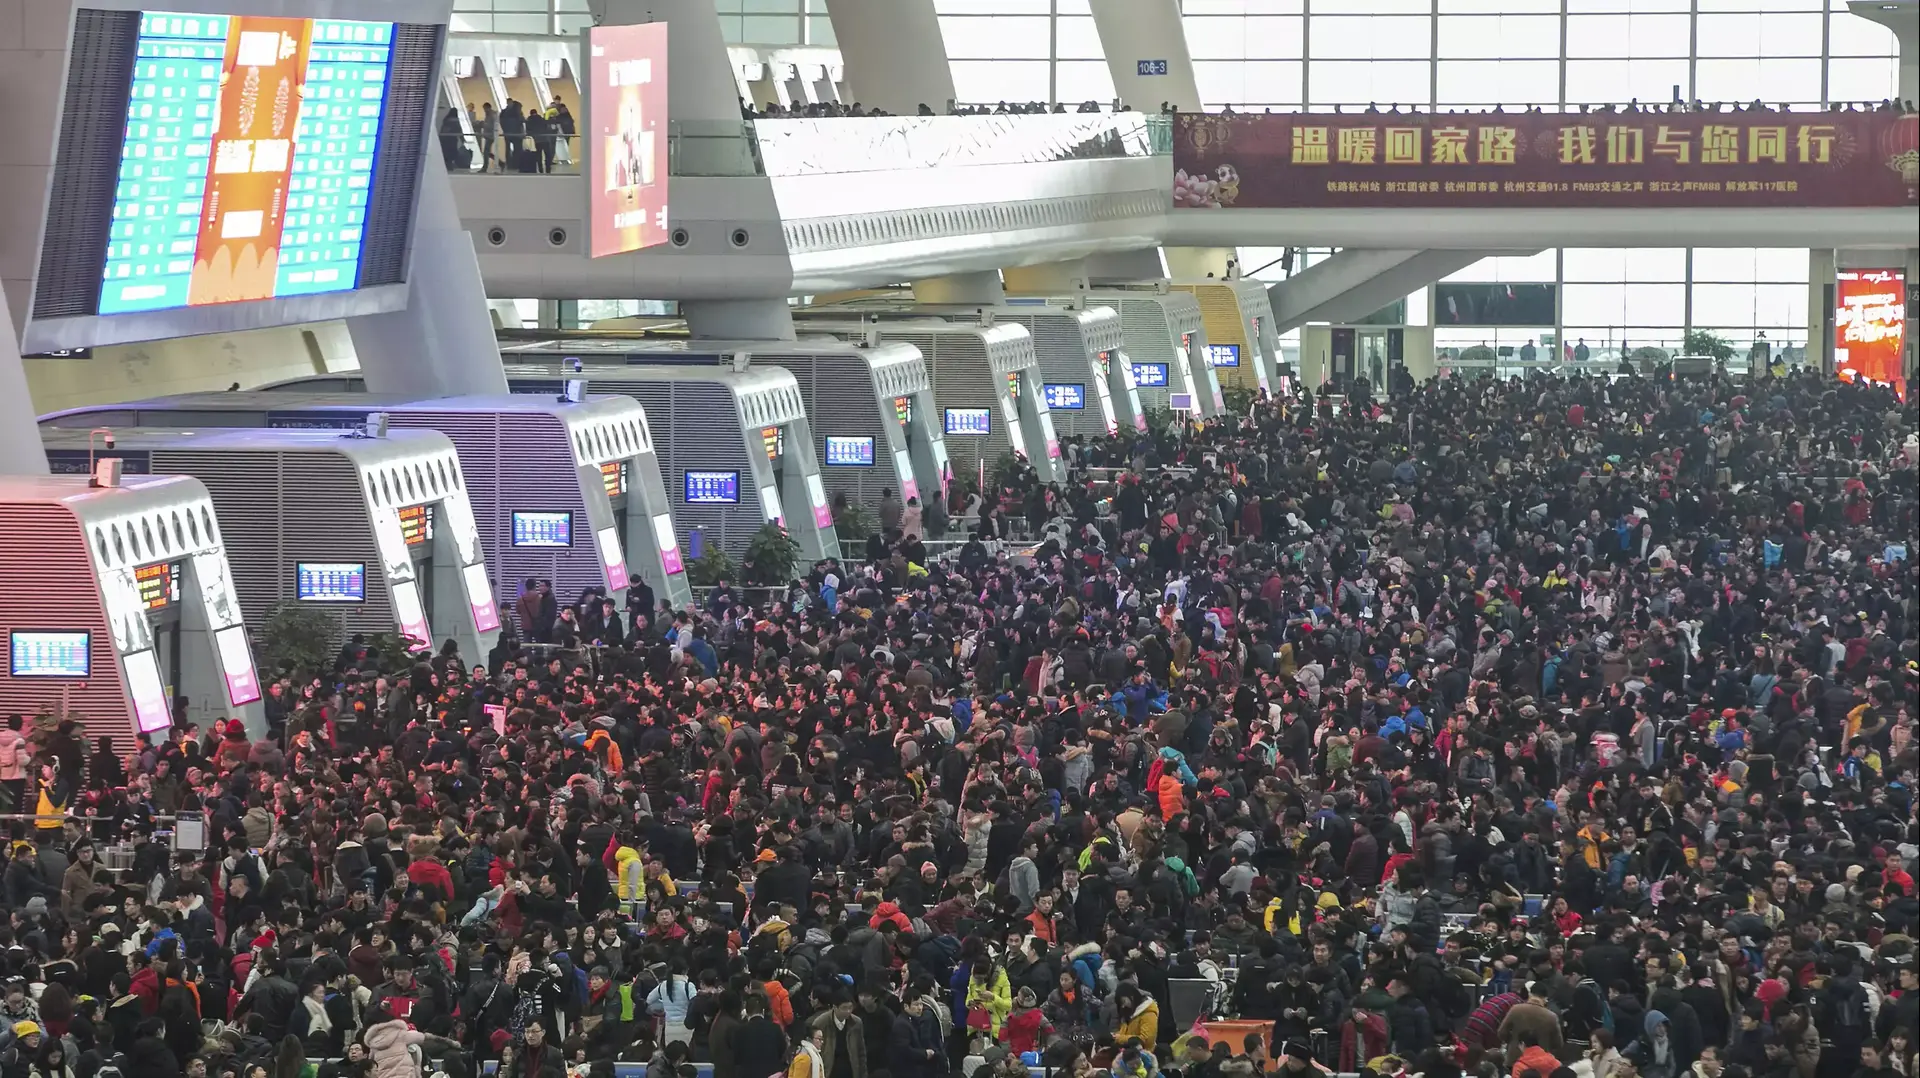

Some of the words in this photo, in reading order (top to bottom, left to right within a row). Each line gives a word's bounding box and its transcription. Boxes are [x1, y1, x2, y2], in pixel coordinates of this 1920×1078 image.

[1139, 62, 1165, 73] 106-3
[1292, 126, 1517, 164] 温暖回家路
[1558, 125, 1835, 164] 我们与您同行
[1327, 181, 1380, 192] 铁路杭州站
[1386, 181, 1439, 192] 浙江团省委
[1444, 181, 1499, 192] 杭州团市委
[1504, 181, 1568, 192] 杭州交通91.8
[1573, 181, 1644, 192] FM93交通之声
[1649, 181, 1721, 192] 浙江之声FM88
[1725, 181, 1798, 192] 解放军117医院
